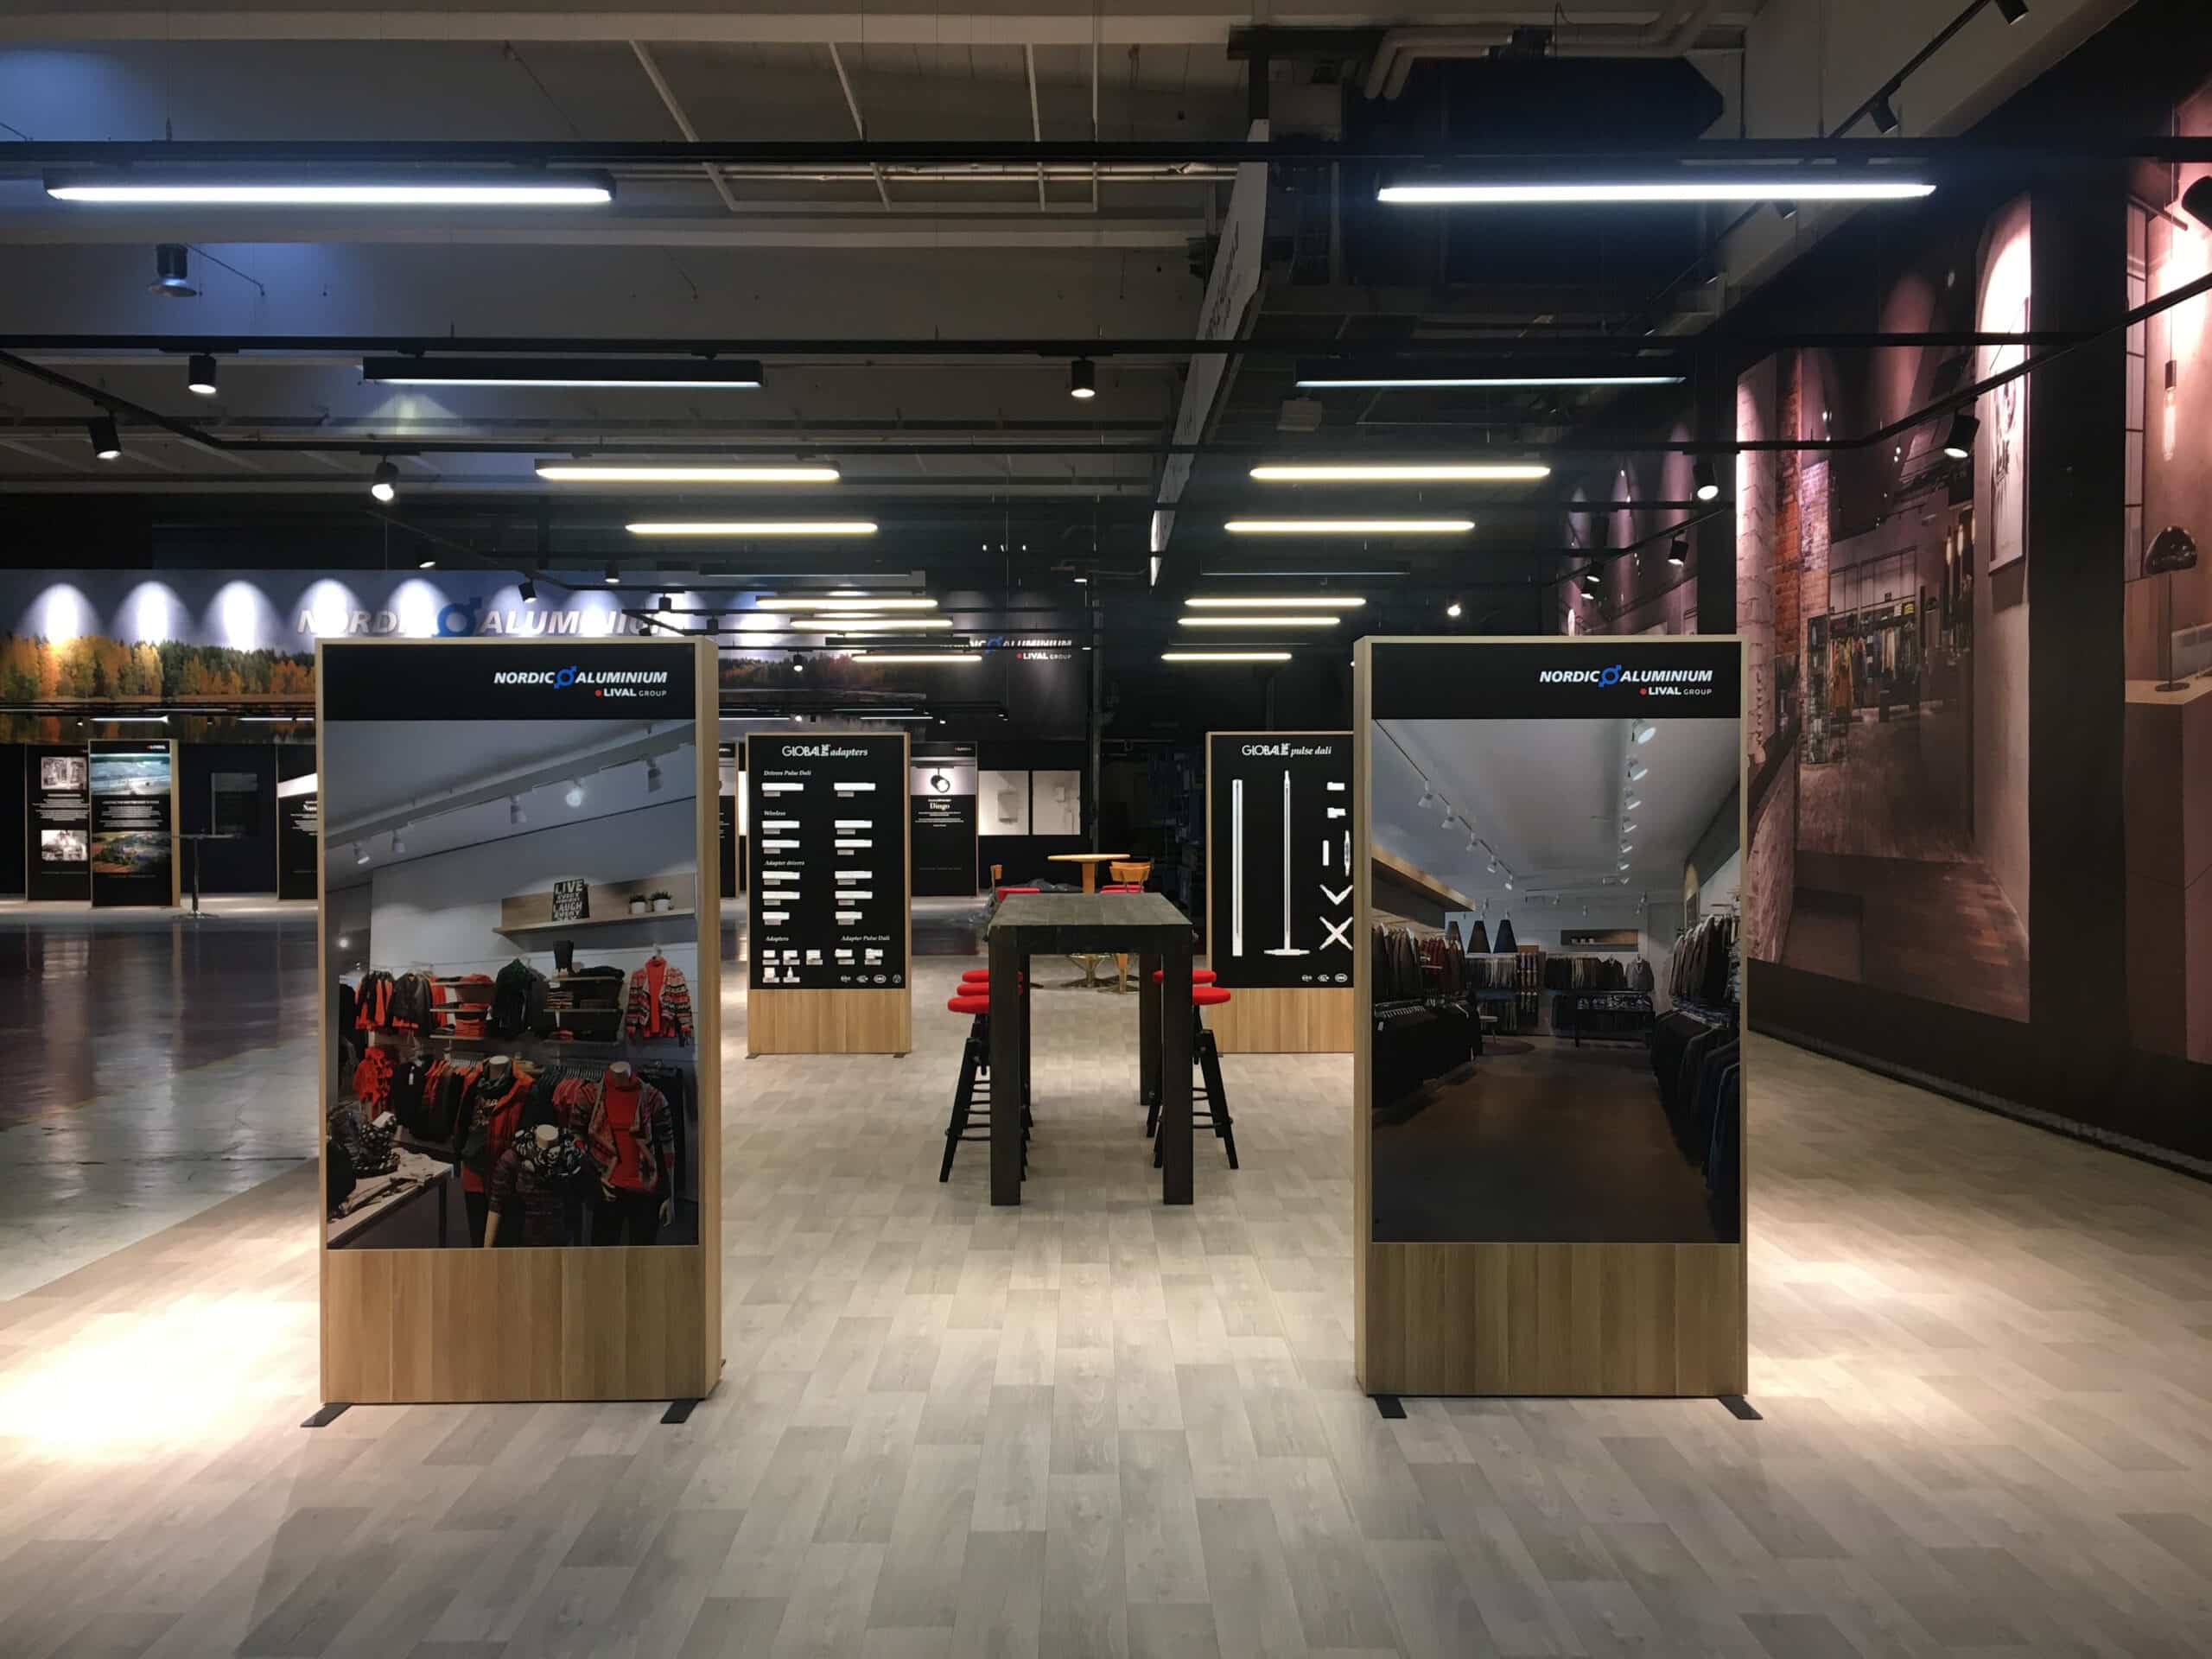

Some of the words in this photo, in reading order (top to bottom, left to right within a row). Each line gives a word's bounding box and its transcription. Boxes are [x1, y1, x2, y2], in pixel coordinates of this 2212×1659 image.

[493, 671, 556, 683] NORDIC
[575, 671, 668, 683] ALUMINIUM
[1539, 670, 1600, 683] NORDIC
[1619, 670, 1713, 683] ALUMINIUM
[604, 689, 636, 697] LIVAL
[1648, 687, 1681, 696] LIVAL
[830, 747, 868, 760] adapters
[1290, 746, 1313, 758] pulse
[1314, 746, 1332, 755] dali
[555, 880, 583, 894] LIVE
[553, 901, 583, 913] LAUGH
